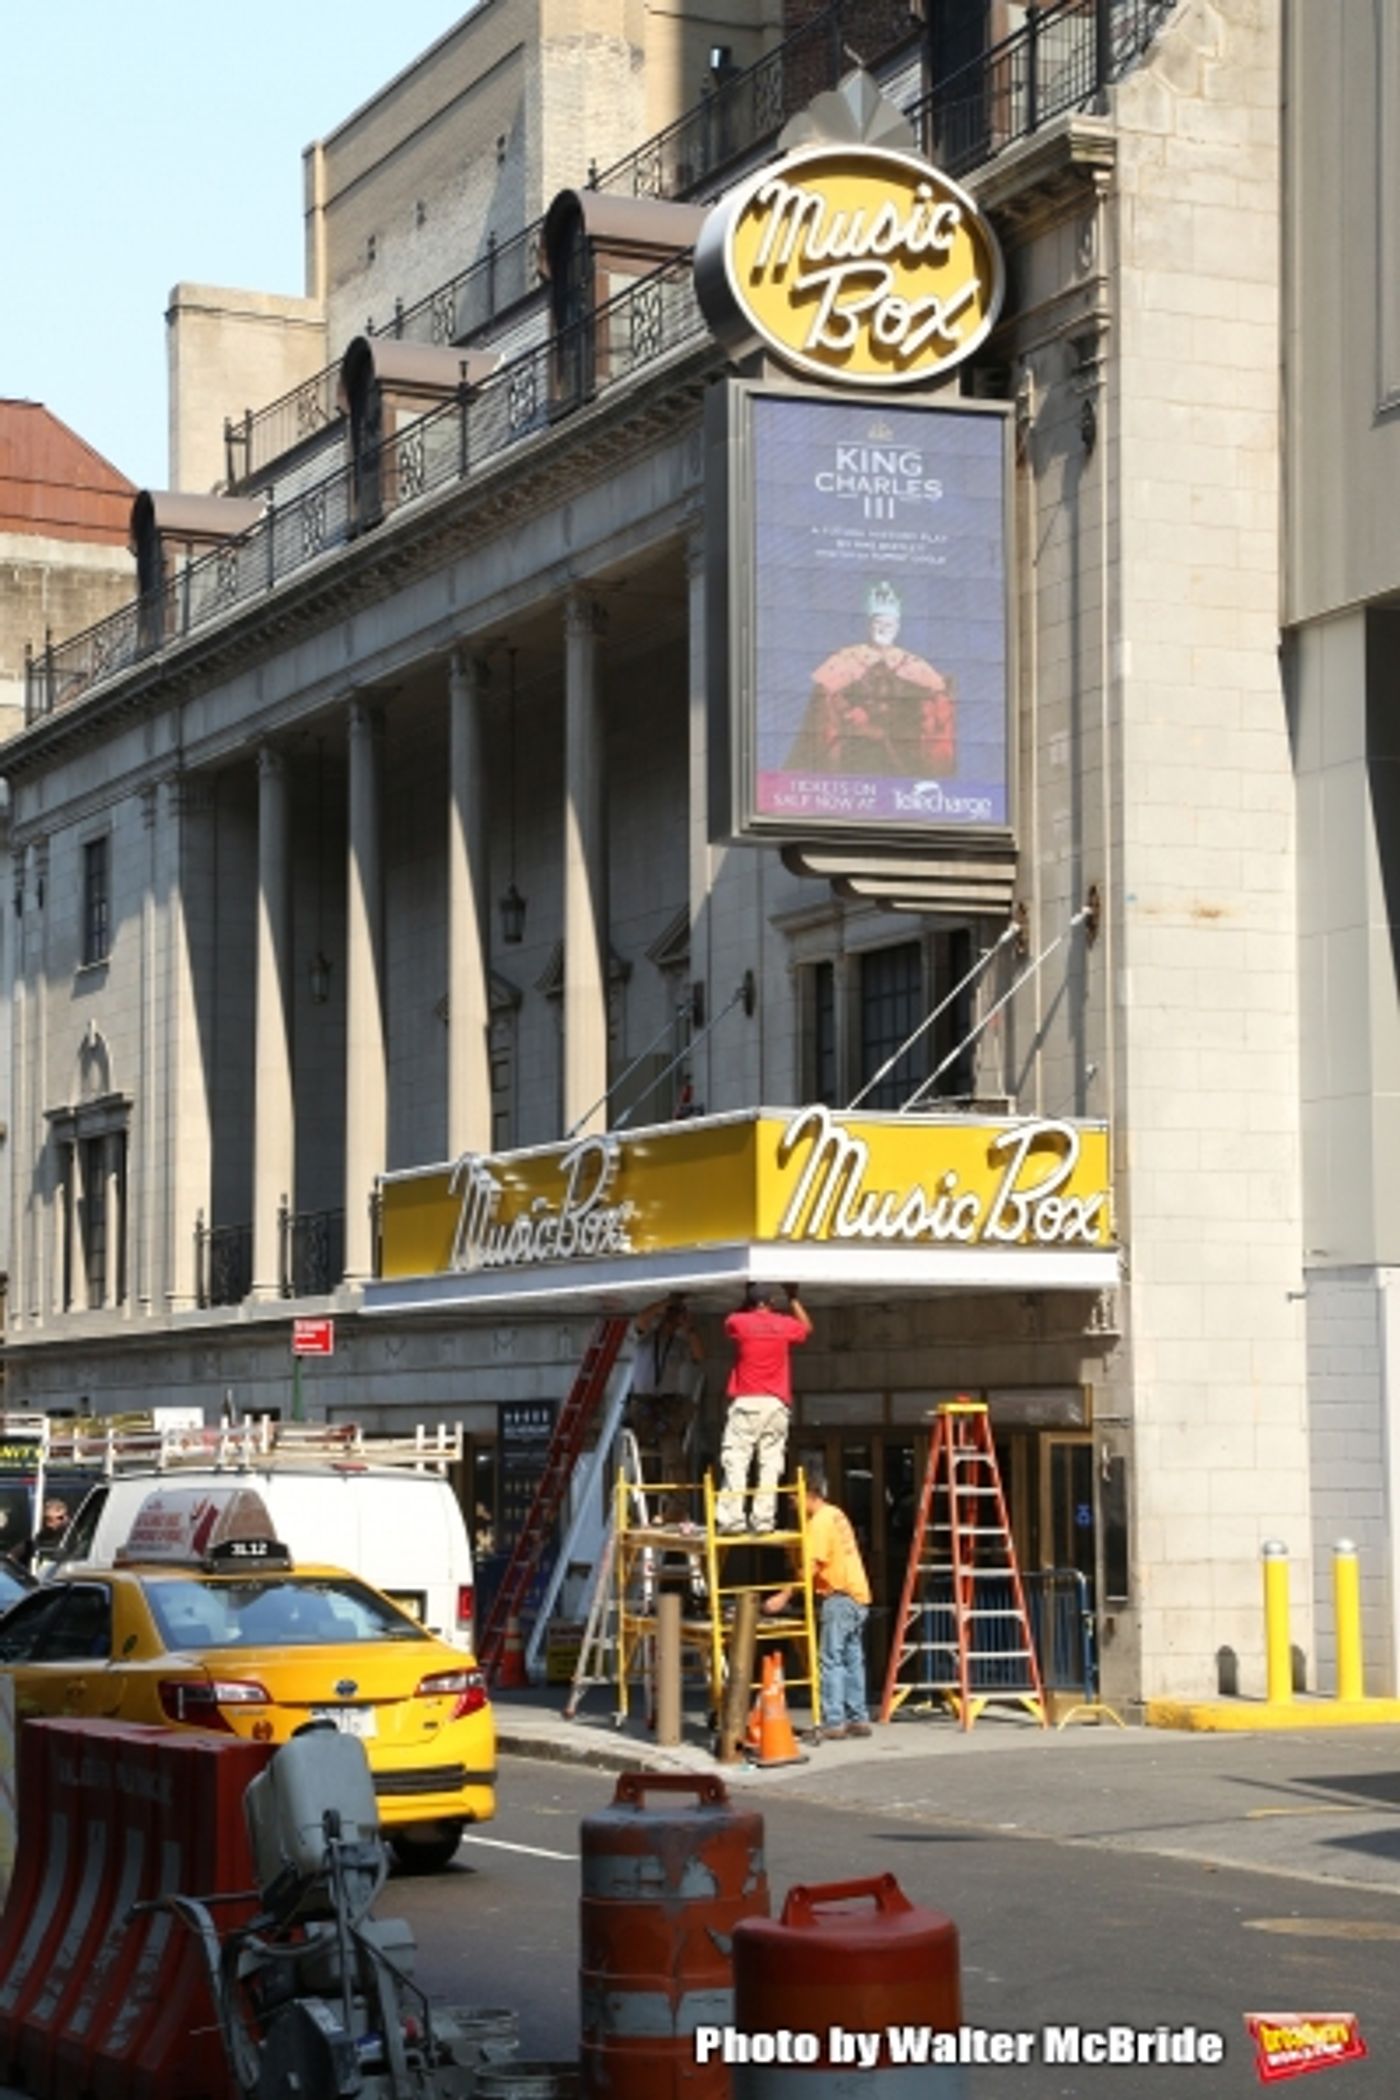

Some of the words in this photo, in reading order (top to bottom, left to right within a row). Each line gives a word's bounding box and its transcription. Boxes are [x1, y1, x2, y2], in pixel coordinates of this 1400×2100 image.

[755, 179, 961, 266] Music
[794, 259, 981, 357] Box
[815, 471, 943, 501] CHARLES
[836, 446, 923, 477] KING
[863, 496, 895, 519] III
[448, 1151, 562, 1273] Music
[555, 1134, 637, 1258] Box
[780, 1104, 981, 1240] Music
[982, 1119, 1111, 1242] Box
